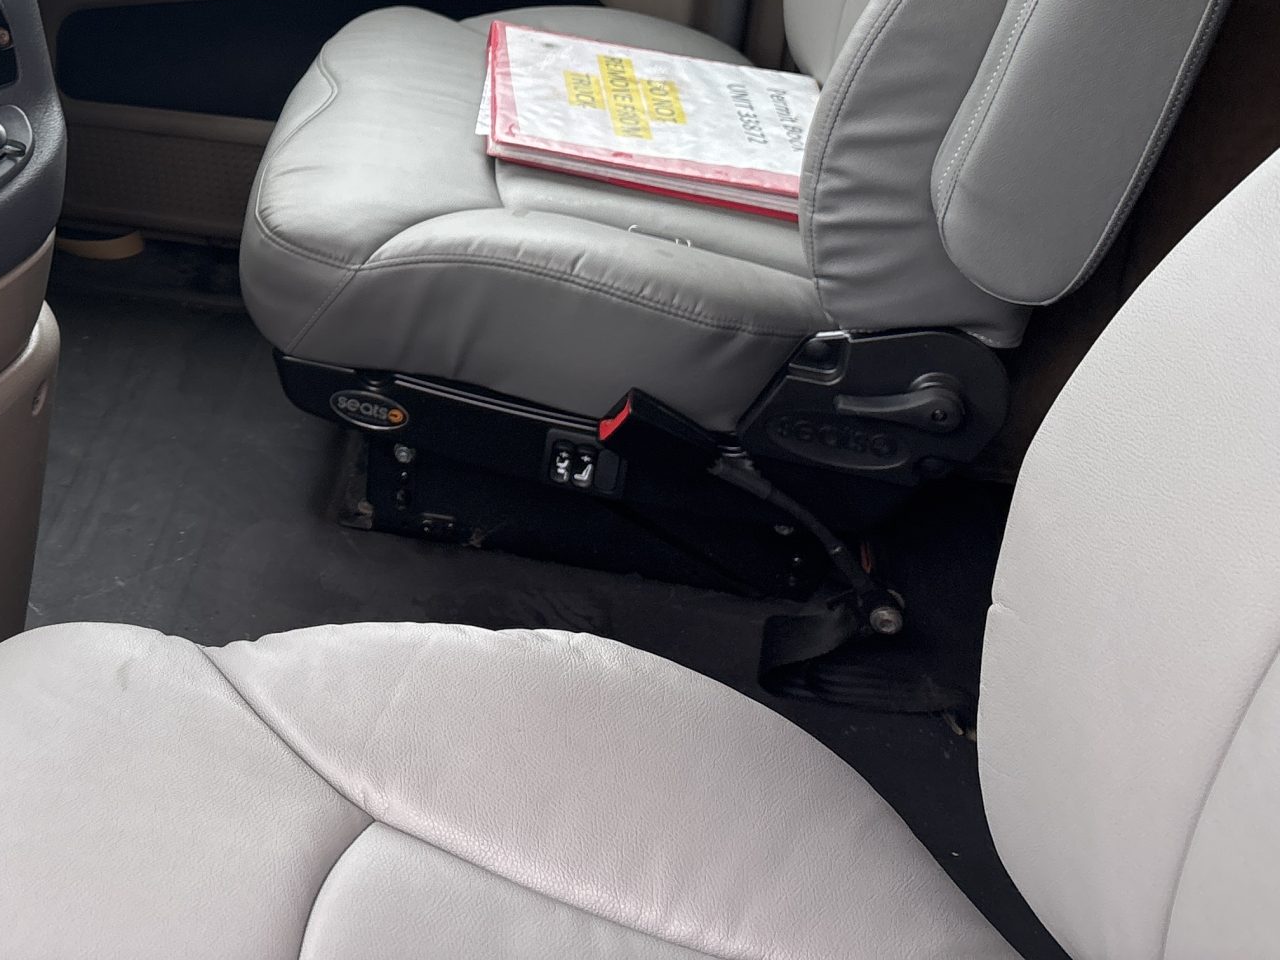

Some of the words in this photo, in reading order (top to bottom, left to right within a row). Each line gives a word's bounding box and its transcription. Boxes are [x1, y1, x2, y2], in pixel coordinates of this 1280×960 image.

[571, 73, 597, 109] TRUCK
[605, 56, 632, 103] REMOVE
[654, 99, 677, 124] NOT
[727, 83, 753, 114] UNIT
[617, 102, 644, 139] FROM
[337, 396, 388, 420] seats
